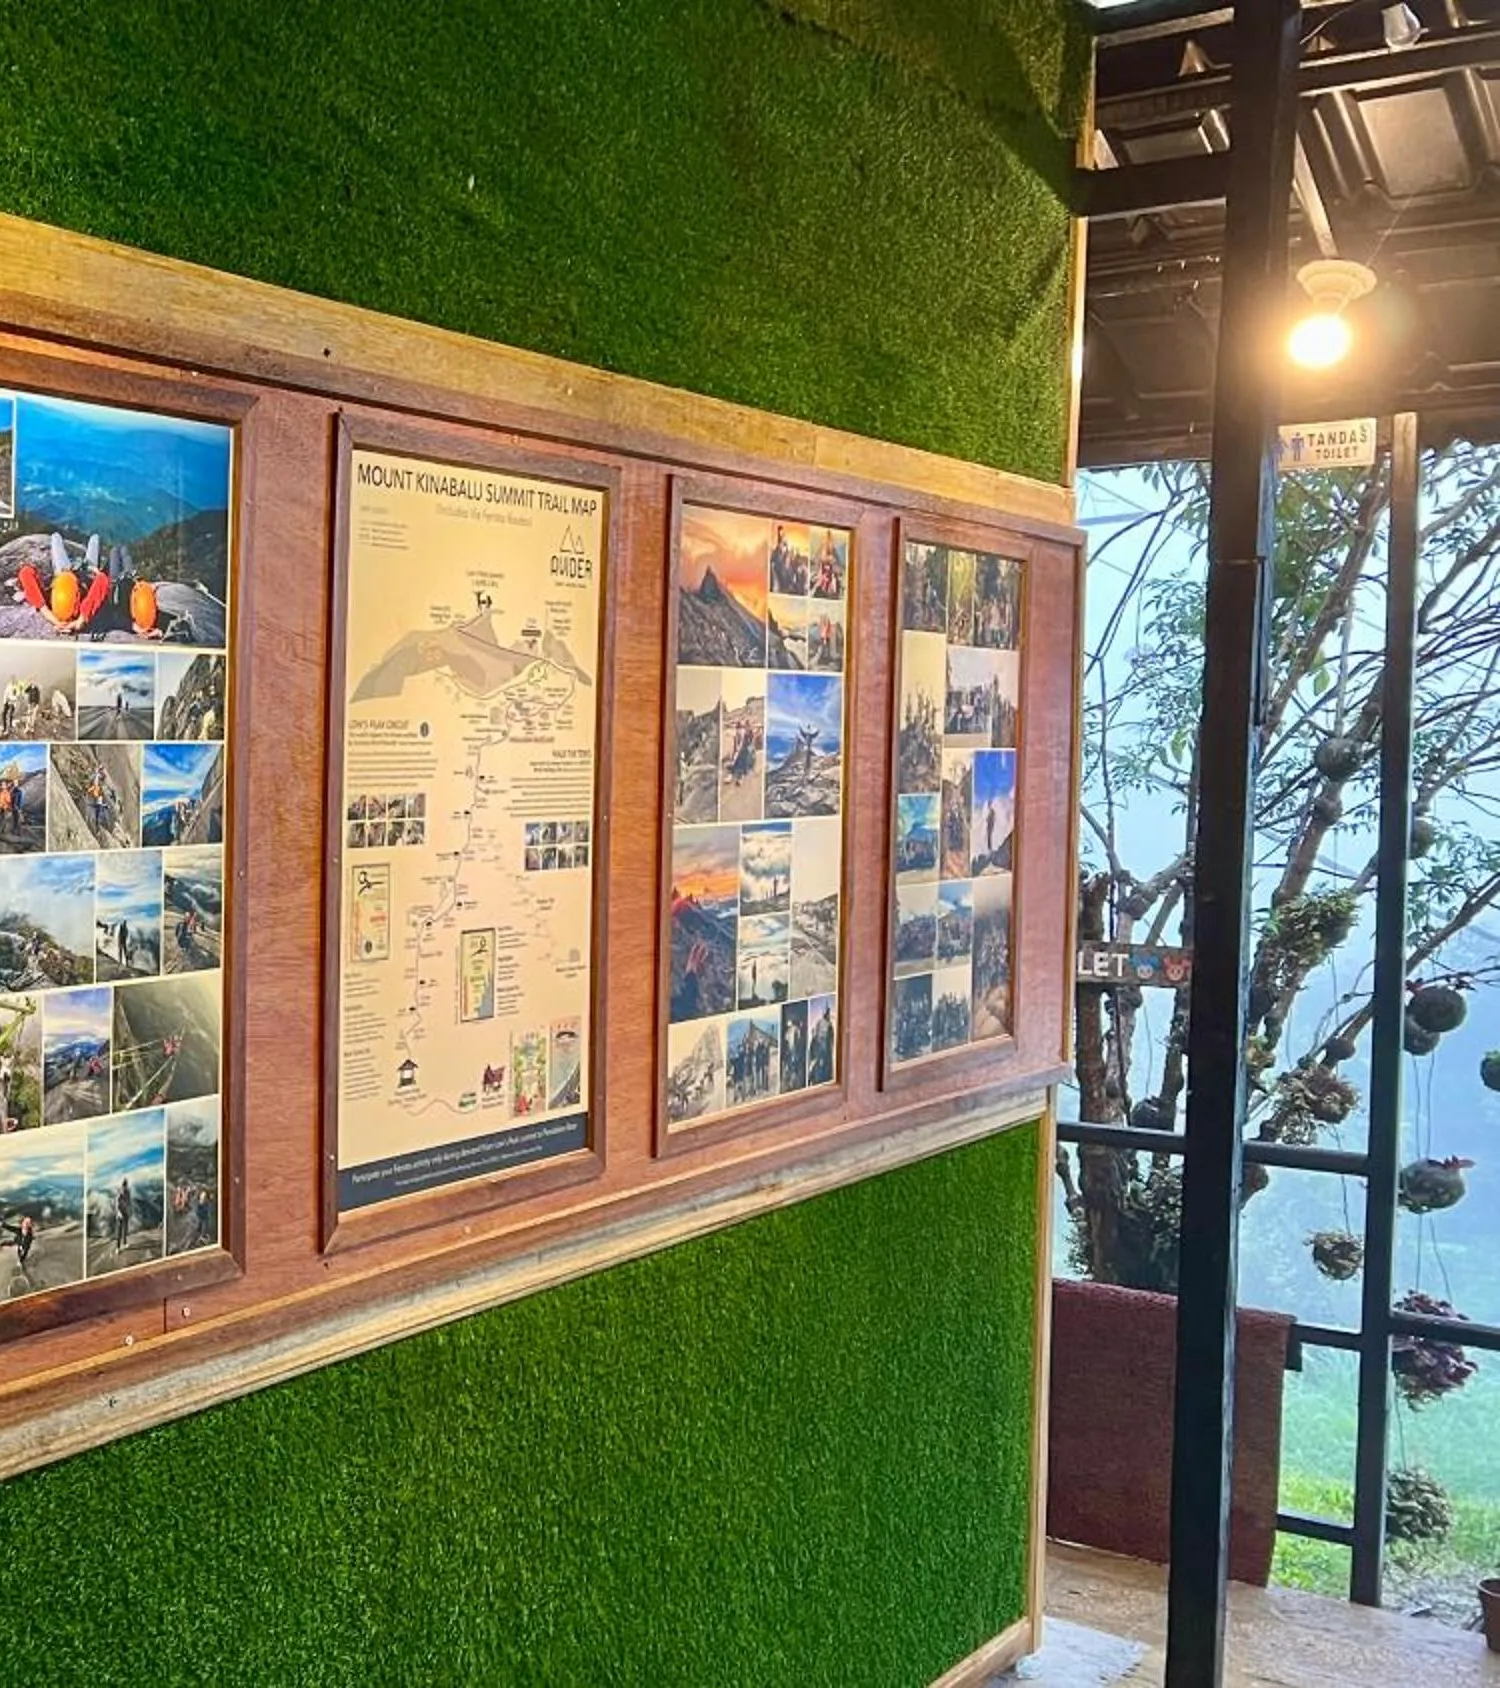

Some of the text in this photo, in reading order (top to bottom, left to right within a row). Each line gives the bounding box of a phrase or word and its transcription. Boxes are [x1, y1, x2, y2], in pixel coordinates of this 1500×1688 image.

[1308, 427, 1367, 447] TANDAS
[1315, 446, 1360, 460] TOILET
[357, 463, 597, 517] MOUNT KINABALU SUMMIT TRAIL MAP
